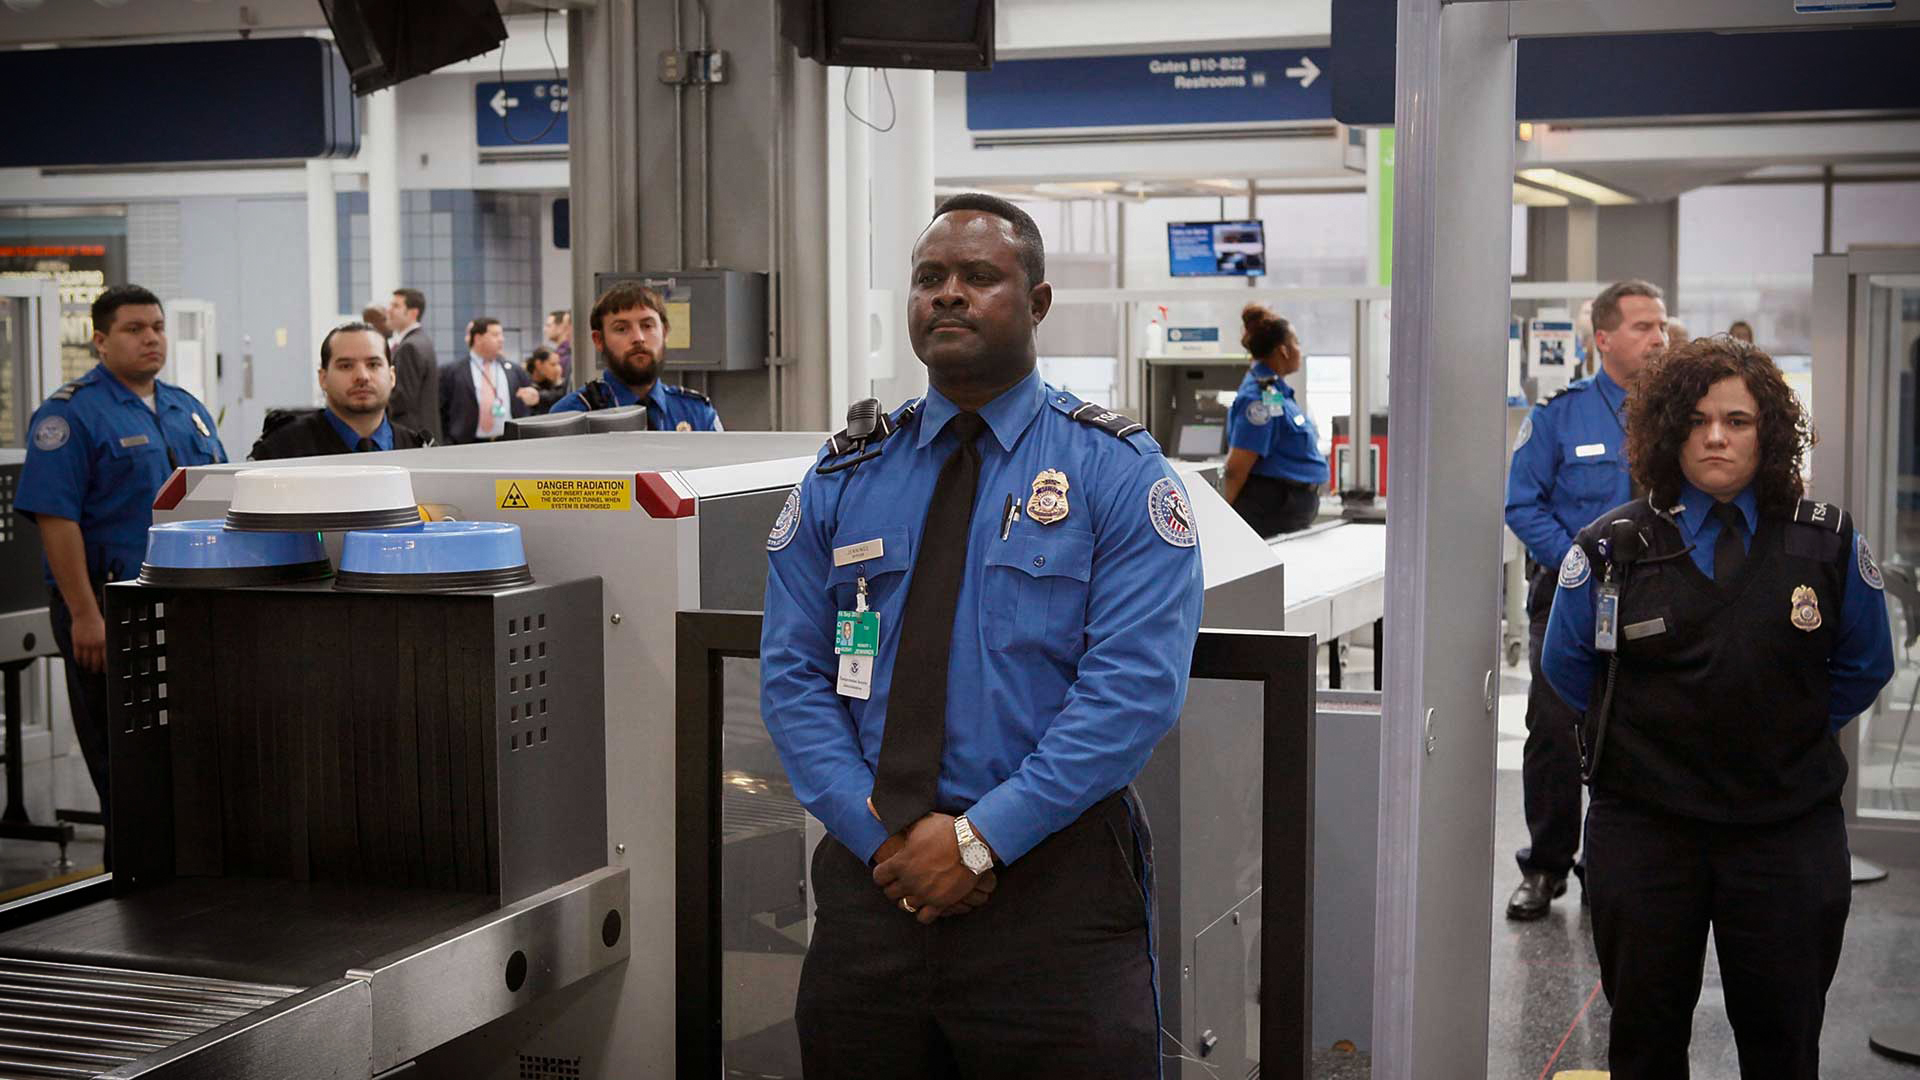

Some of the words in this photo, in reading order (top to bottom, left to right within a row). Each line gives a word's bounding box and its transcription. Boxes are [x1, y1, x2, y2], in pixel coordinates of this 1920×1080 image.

[1149, 60, 1188, 74] Gates
[1174, 75, 1246, 89] Restrooms
[537, 481, 574, 490] DANGER
[577, 481, 624, 490] RADIATION
[1812, 502, 1827, 521] TSA
